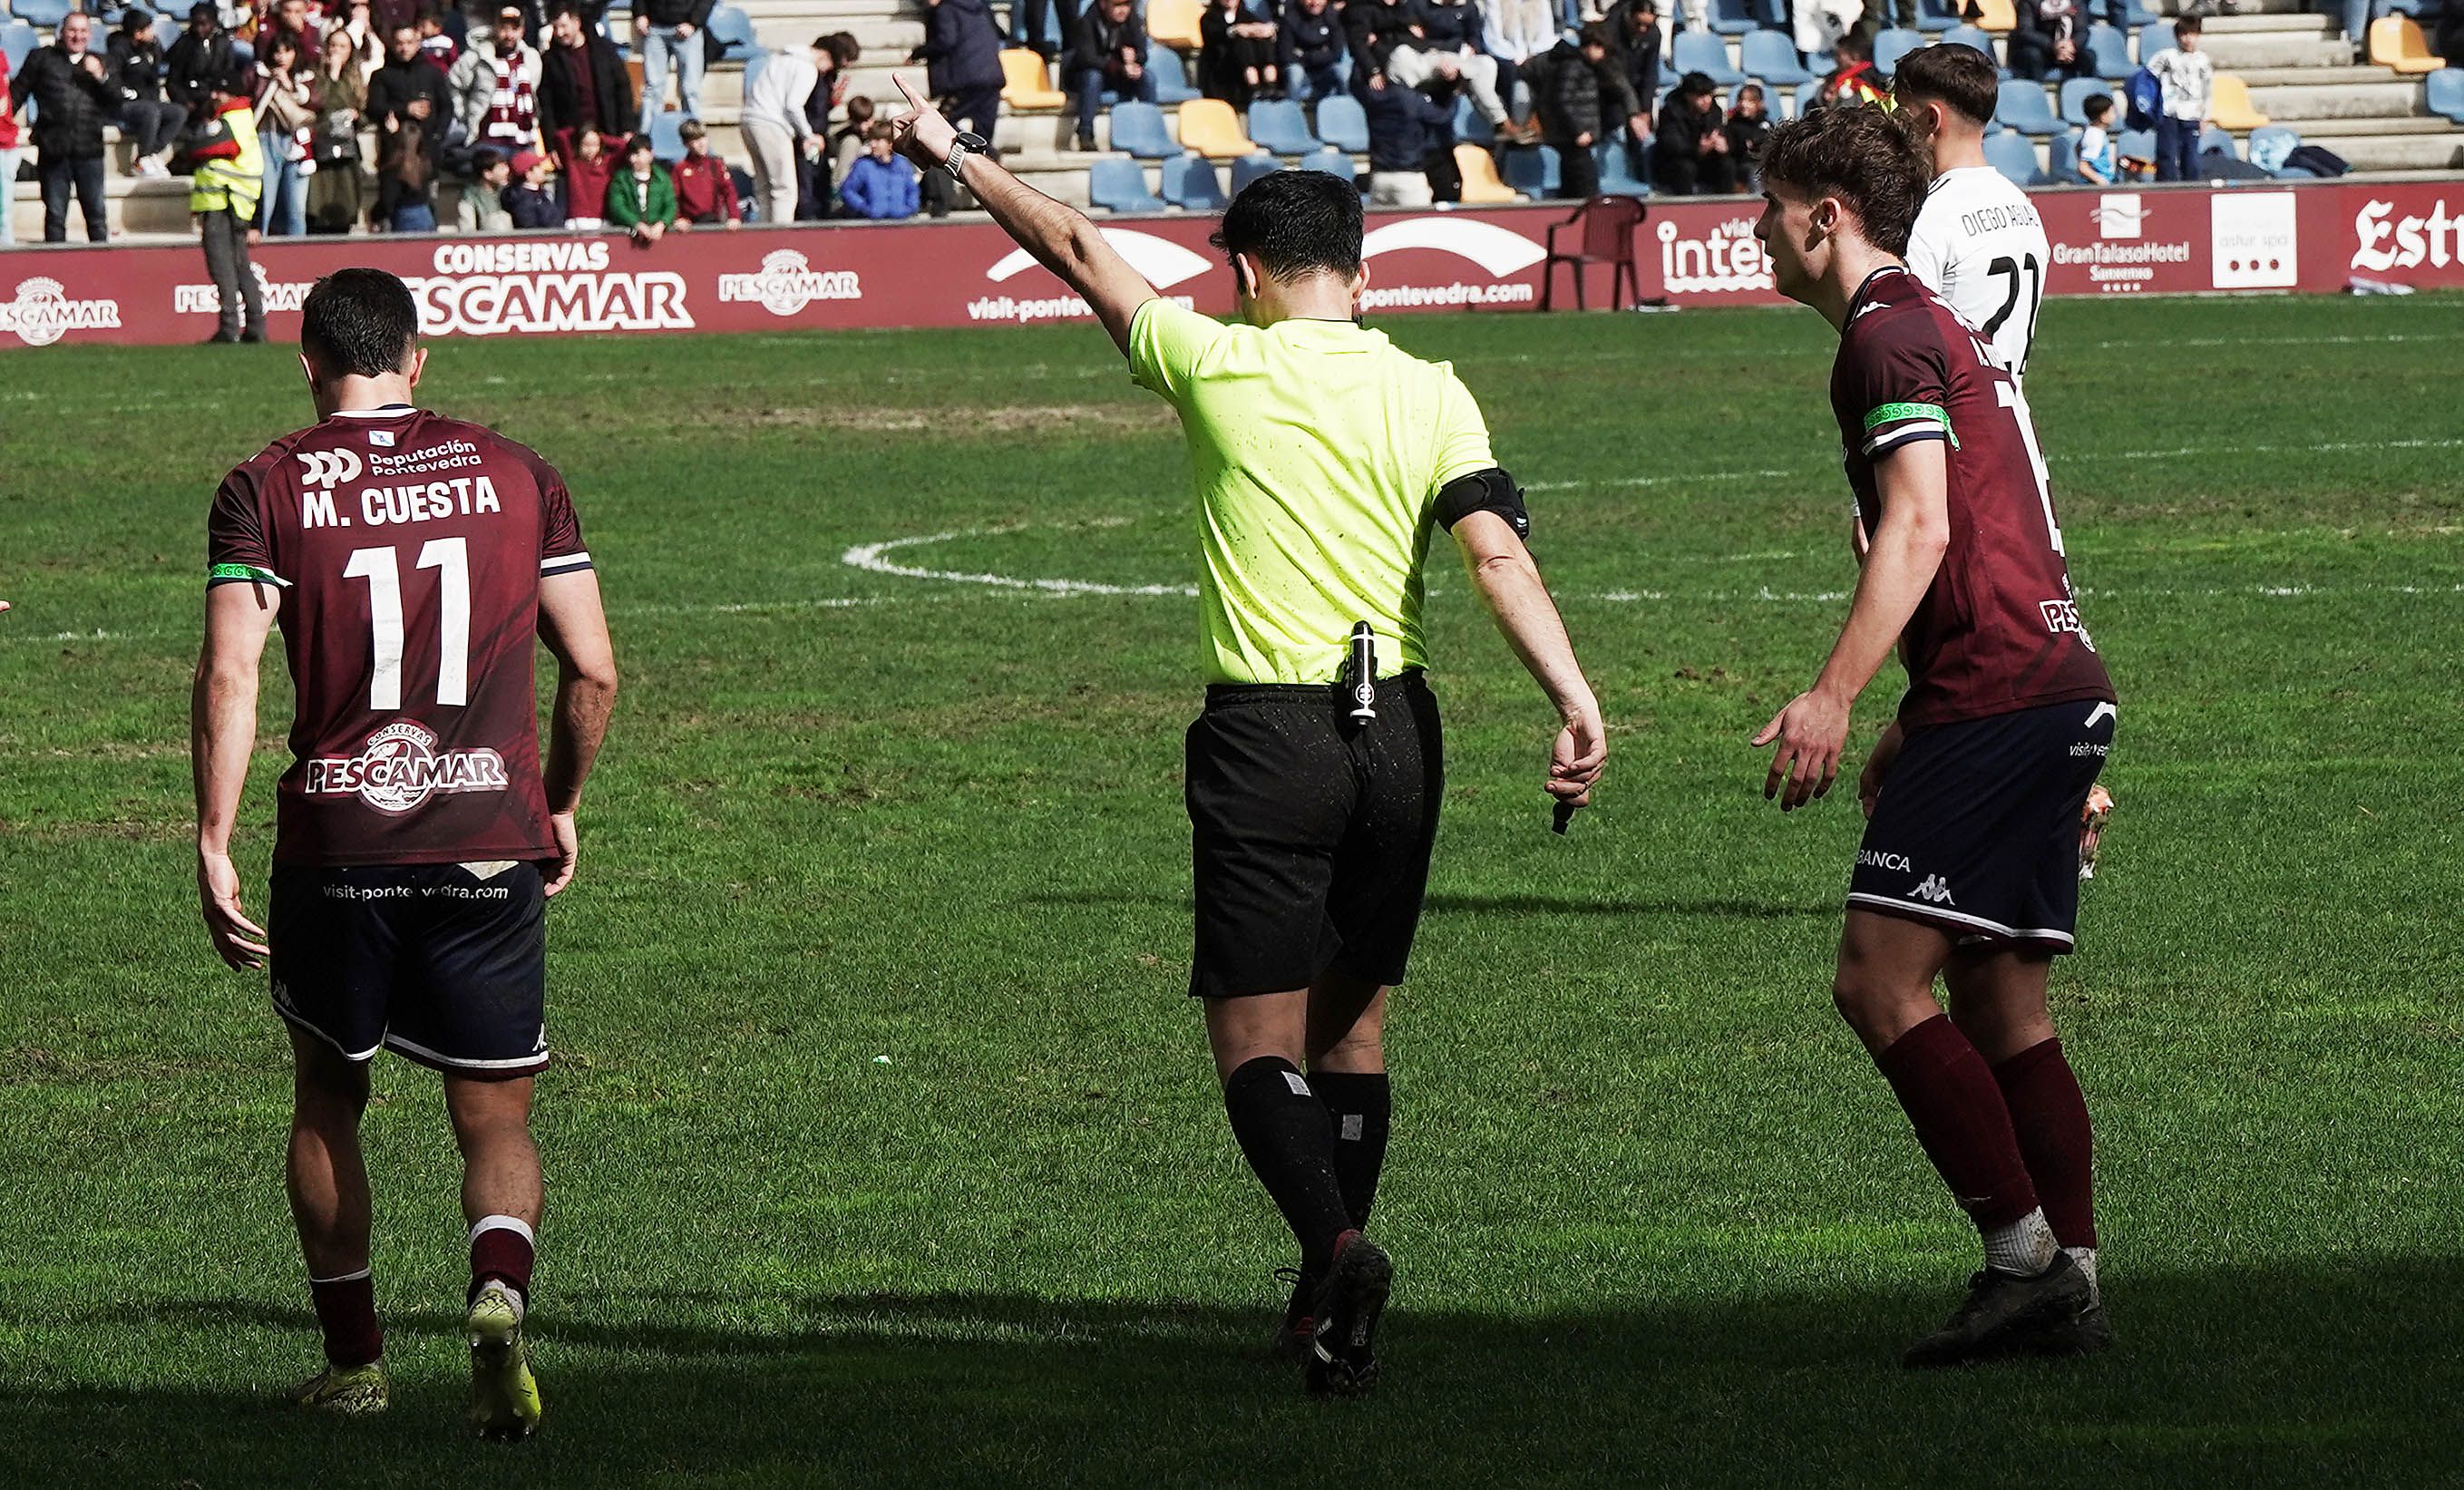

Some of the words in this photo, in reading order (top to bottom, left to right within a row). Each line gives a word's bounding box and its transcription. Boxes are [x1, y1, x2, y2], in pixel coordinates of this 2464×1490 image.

[1962, 207, 2008, 237] DIEGO
[433, 241, 610, 274] CONSERVAS
[2052, 241, 2190, 265] GranTalasoHotel
[713, 270, 862, 302] PESCAMAR
[1982, 252, 2040, 375] 21
[369, 439, 478, 468] Deputación
[372, 453, 482, 477] Pontevedra
[302, 490, 351, 529] M.
[360, 476, 502, 527] CUESTA
[342, 537, 472, 711] 11
[367, 723, 433, 746] CONSERVAS
[305, 752, 510, 794] PESCAMAR
